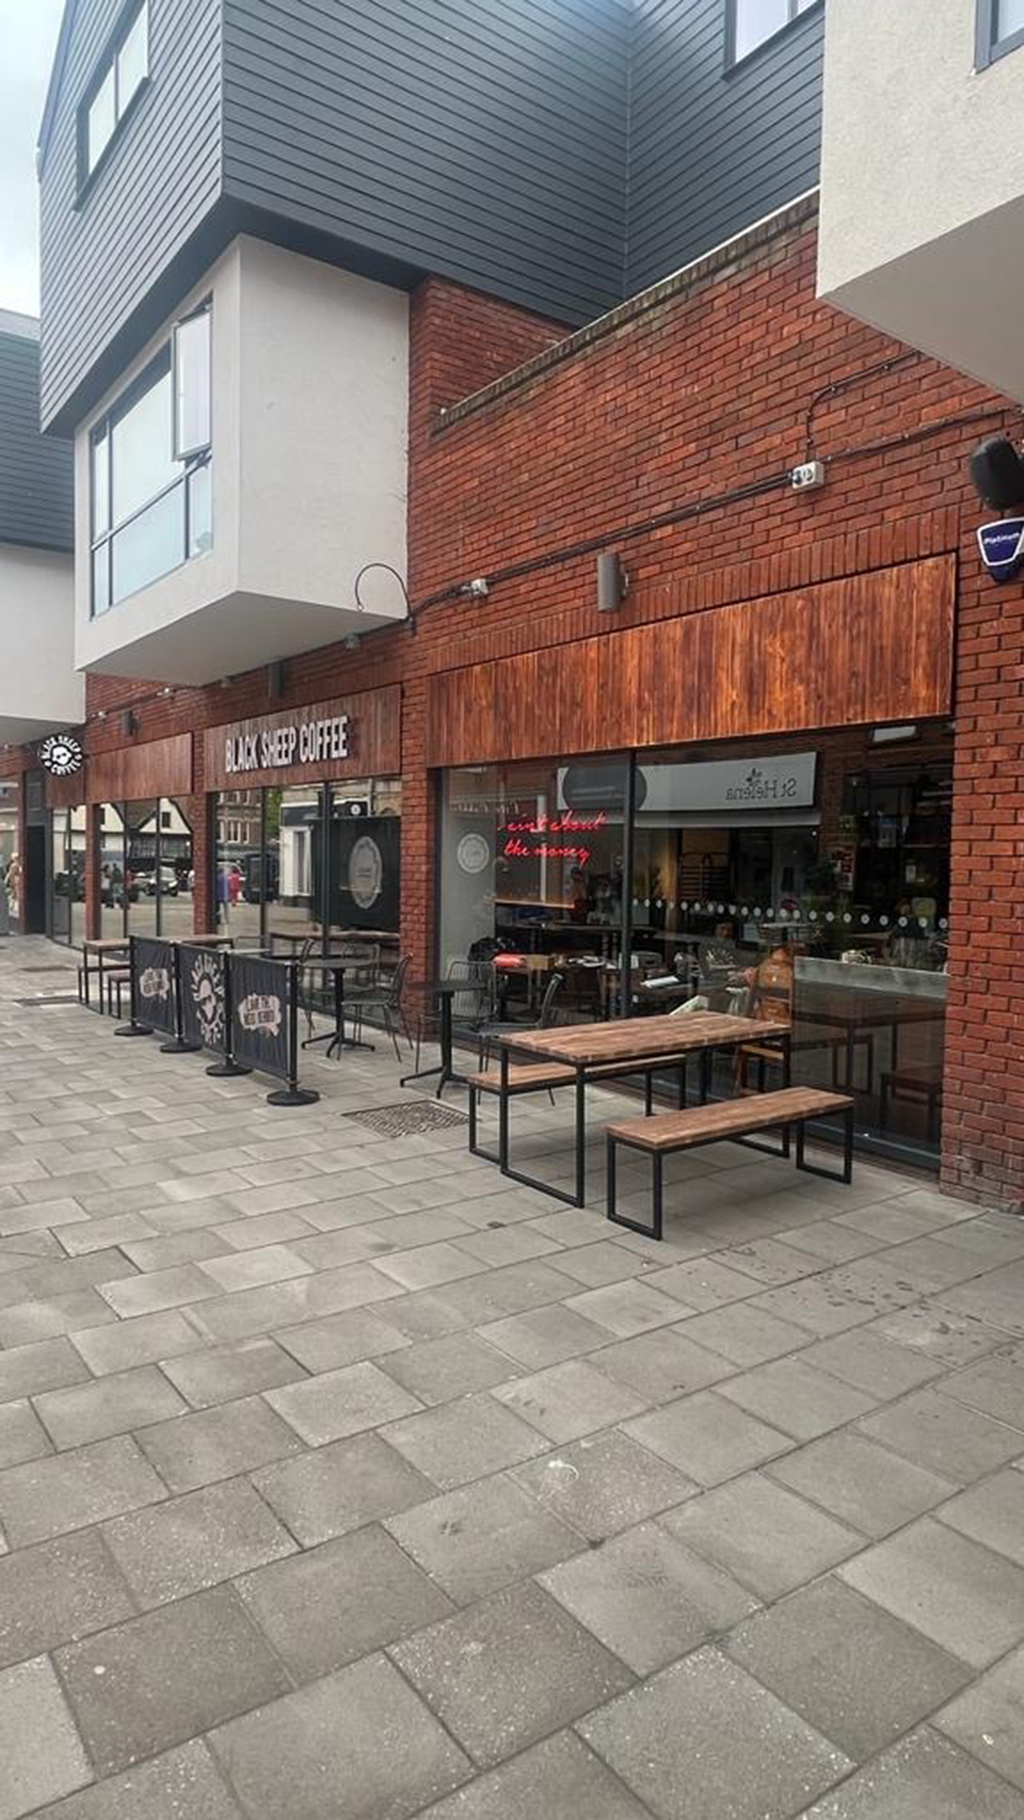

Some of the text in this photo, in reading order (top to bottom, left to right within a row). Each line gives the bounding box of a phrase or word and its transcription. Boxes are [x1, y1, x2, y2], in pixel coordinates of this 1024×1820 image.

[225, 715, 348, 773] BLACK SHEEP COFFEE
[504, 838, 530, 857] the
